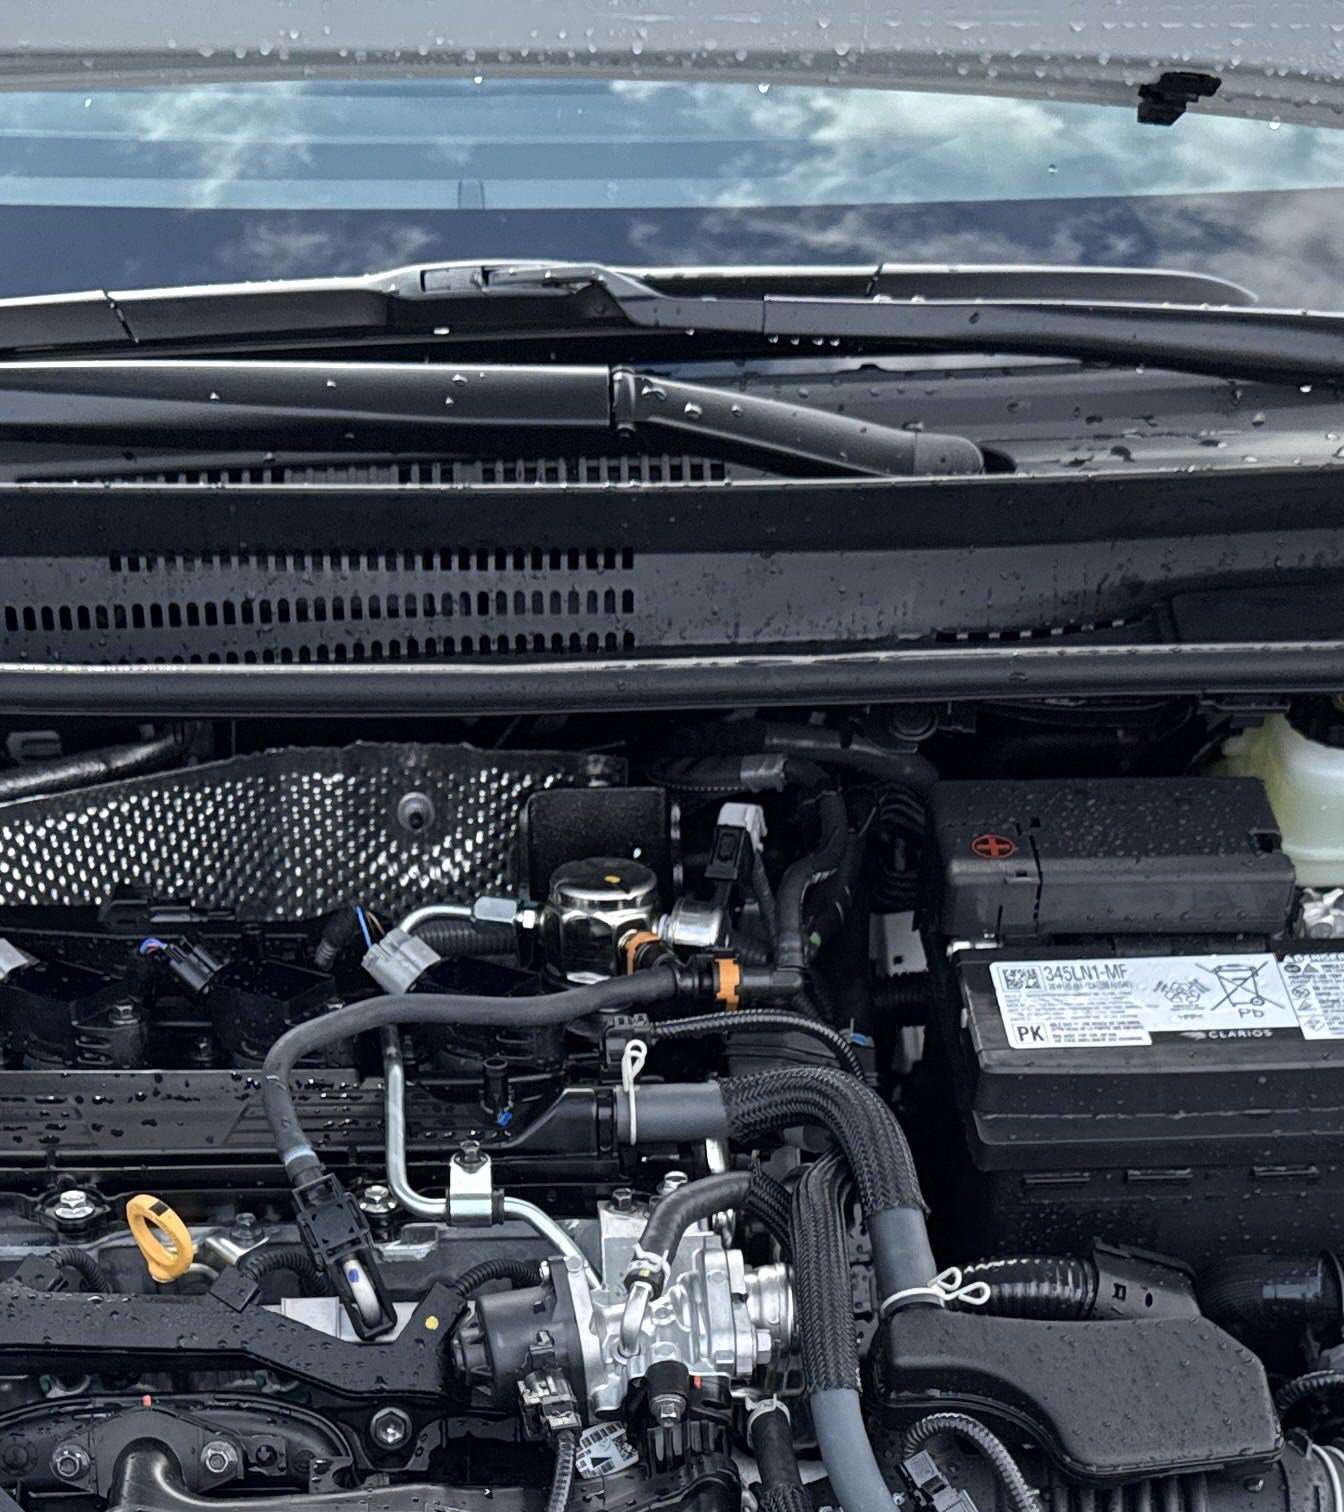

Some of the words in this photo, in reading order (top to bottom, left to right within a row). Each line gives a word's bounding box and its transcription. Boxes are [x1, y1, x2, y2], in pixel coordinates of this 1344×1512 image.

[1044, 963, 1128, 983] 345LN1-MF
[1238, 1008, 1265, 1019] Pb
[1017, 1026, 1044, 1042] PK
[1208, 1030, 1273, 1040] CLARIOS
